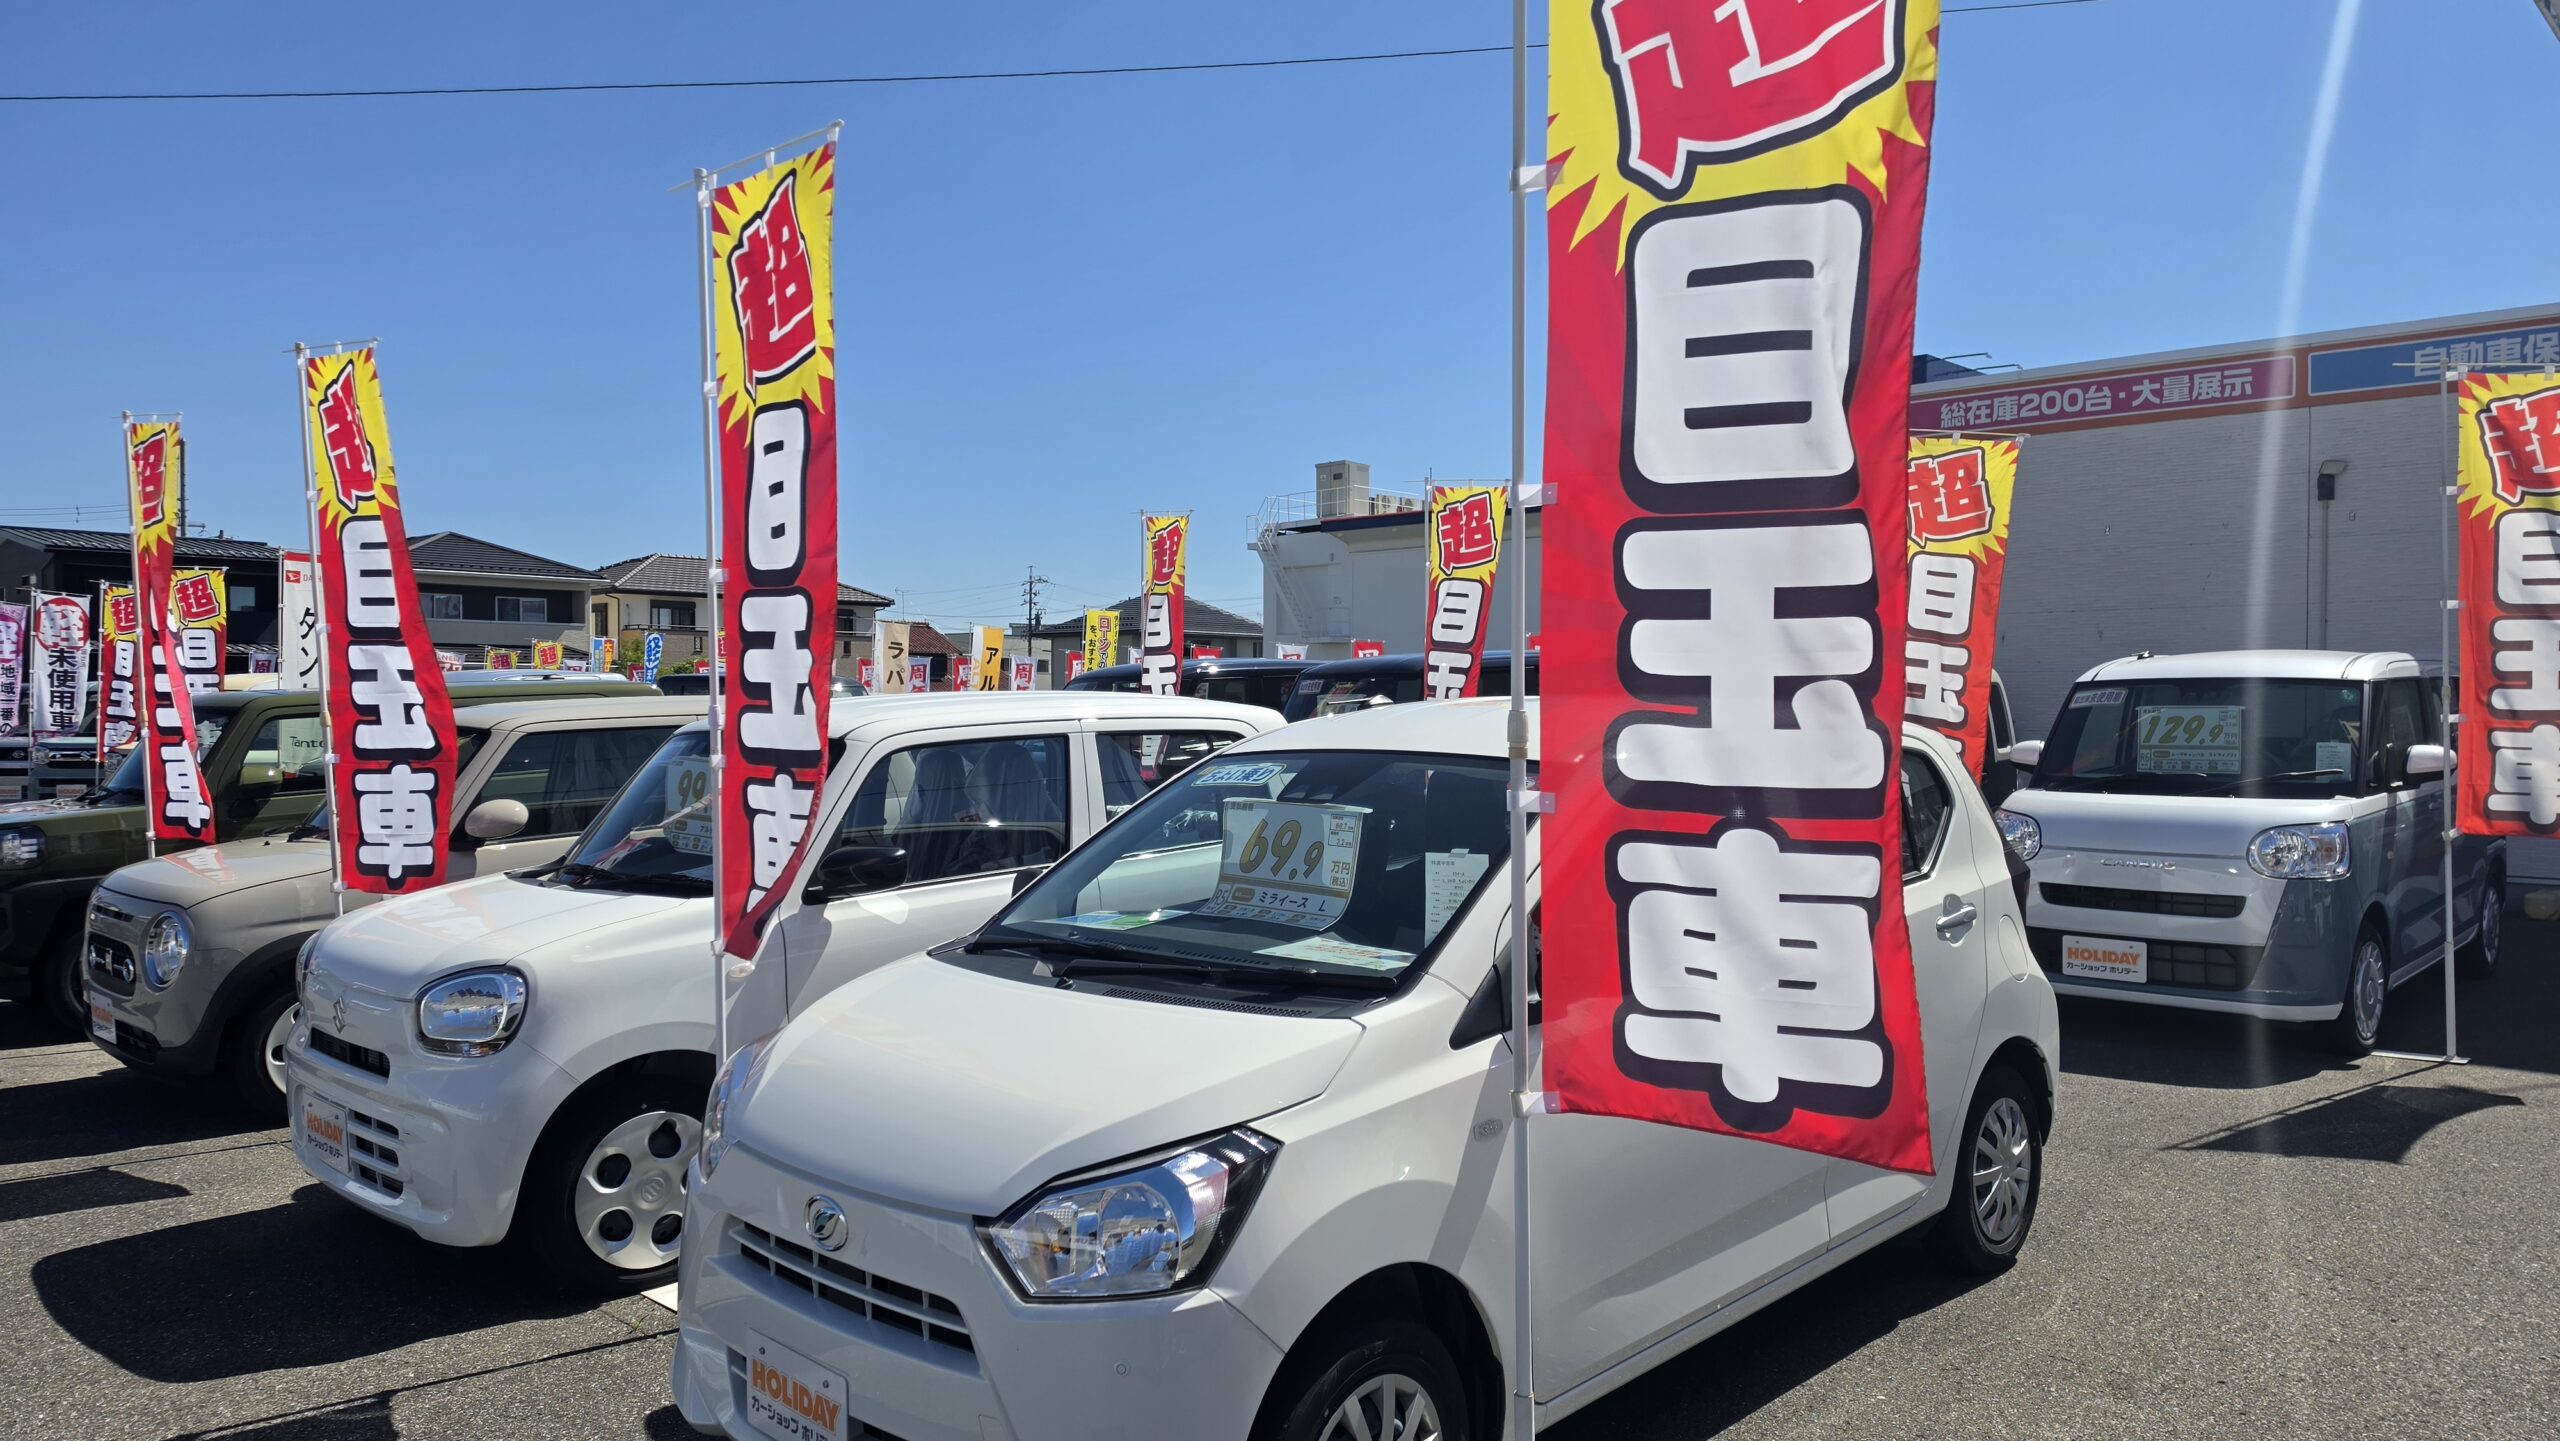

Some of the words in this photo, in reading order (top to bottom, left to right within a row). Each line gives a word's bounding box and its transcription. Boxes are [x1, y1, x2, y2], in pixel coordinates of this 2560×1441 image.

[1940, 367, 2253, 429] 総在庫200台・大量展示
[1905, 446, 1993, 748] 超目玉
[40, 603, 84, 648] 軽
[540, 645, 558, 667] 超
[887, 641, 905, 685] ラパ
[980, 646, 999, 690] アル
[48, 648, 77, 730] 未使用車
[2142, 715, 2224, 744] 129.9
[1239, 818, 1325, 880] 69.9
[1331, 861, 1350, 875] 万円
[1260, 891, 1309, 909] ミライース
[1319, 899, 1326, 912] L
[2066, 961, 2107, 972] カーショップ
[2109, 967, 2139, 975] ホリデー
[2067, 946, 2140, 966] HOLIDAY
[307, 1110, 343, 1145] HOLIDAY
[751, 1358, 840, 1433] HOLIDAY
[752, 1395, 799, 1434] カーショップ
